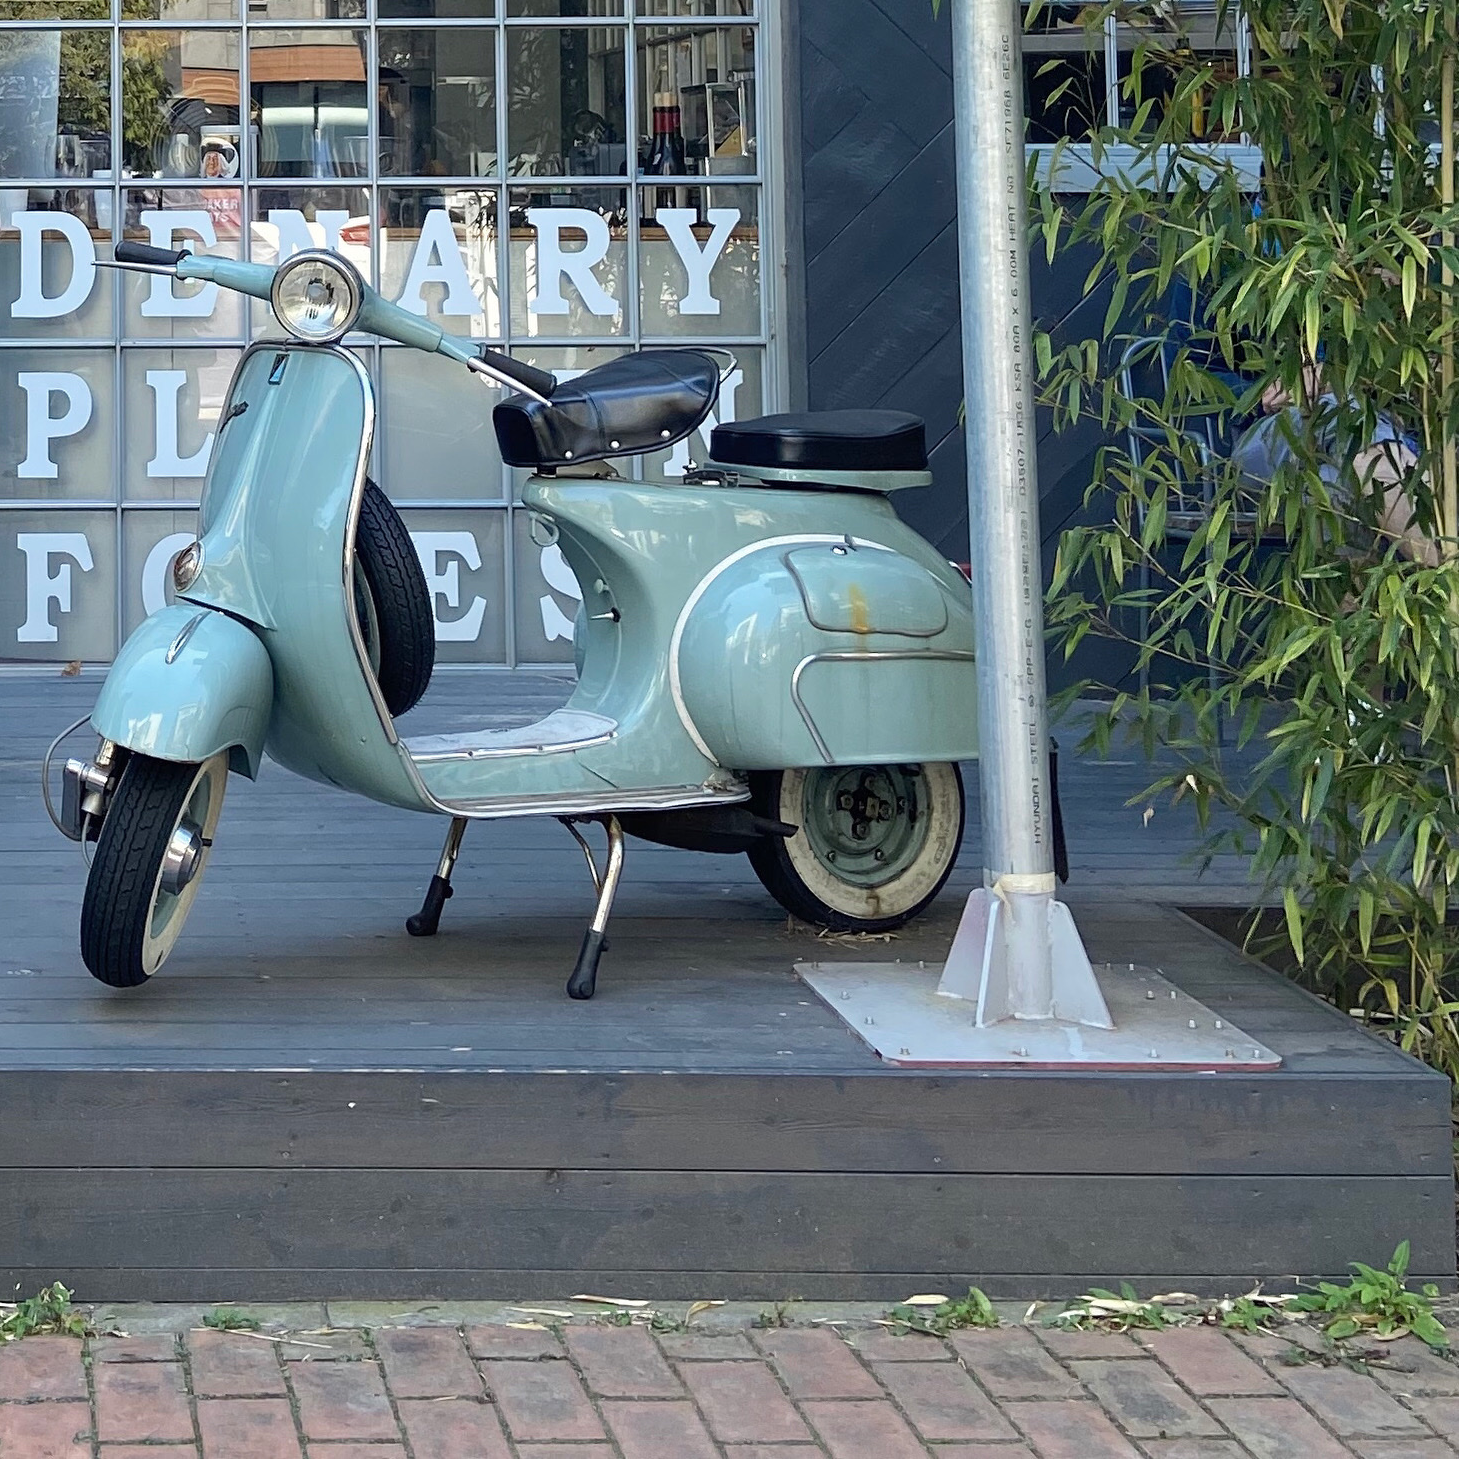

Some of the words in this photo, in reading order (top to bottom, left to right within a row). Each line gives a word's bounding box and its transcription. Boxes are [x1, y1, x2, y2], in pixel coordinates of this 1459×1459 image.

[1007, 204, 1016, 241] HEAT
[1028, 721, 1039, 765] STEEL
[1031, 777, 1042, 844] HYUNDAI
